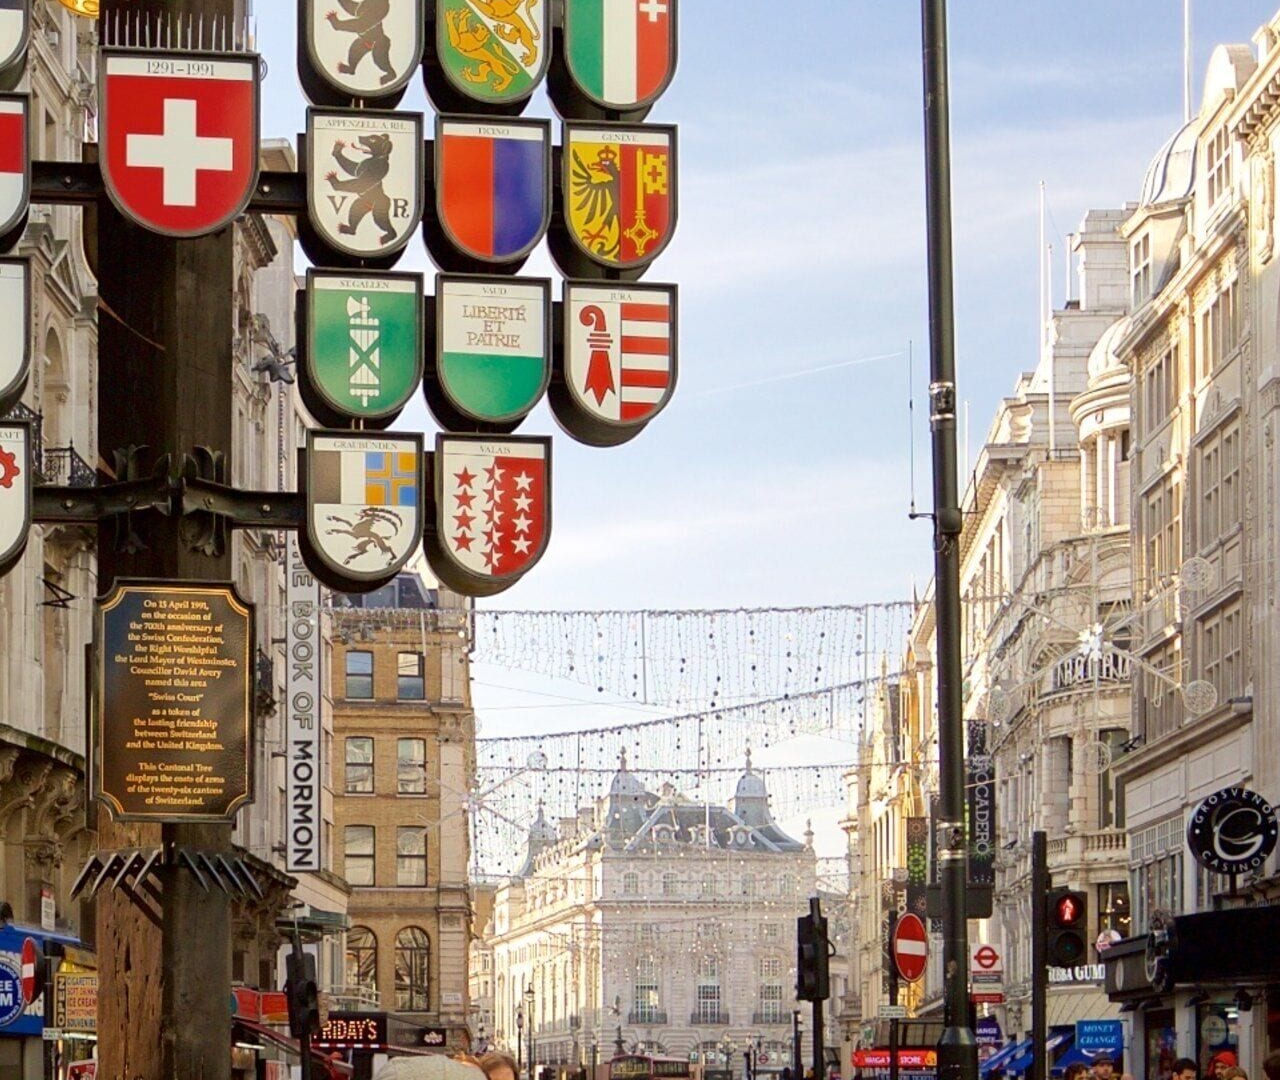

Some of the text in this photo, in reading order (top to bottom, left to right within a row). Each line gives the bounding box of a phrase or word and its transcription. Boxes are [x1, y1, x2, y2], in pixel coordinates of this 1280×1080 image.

[477, 125, 510, 136] TICINO
[328, 195, 409, 218] V R
[482, 286, 508, 295] VAUD
[610, 291, 633, 302] JURA
[462, 304, 527, 323] LIBERTÉ
[483, 320, 505, 333] ET
[466, 331, 520, 348] PATRIE
[479, 445, 512, 456] VALAIS
[144, 600, 156, 608] On
[169, 601, 189, 610] April
[168, 612, 201, 620] occasion
[167, 623, 212, 633] anniversary
[292, 601, 313, 681] BOOK
[135, 644, 148, 652] the
[150, 645, 171, 654] Right
[130, 655, 148, 663] Lord
[150, 656, 175, 665] Mayor
[177, 656, 185, 664] of
[131, 666, 172, 674] Councillor
[199, 669, 222, 678] Avery
[145, 678, 172, 686] named
[174, 679, 189, 687] this
[292, 691, 313, 730] OF
[148, 719, 175, 728] lasting
[176, 720, 218, 729] friendship
[135, 729, 216, 738] between Switzerland
[157, 741, 183, 749] United
[139, 762, 213, 772] This Cantonal Tree
[126, 774, 158, 784] displays
[160, 774, 172, 782] the
[195, 775, 204, 783] of
[145, 796, 154, 804] of
[292, 740, 313, 866] MORMON
[1195, 788, 1277, 824] GROSVENOR
[1202, 851, 1268, 873] CASINOS
[1075, 964, 1106, 981] GUM
[57, 976, 65, 1026] OPEN
[1083, 1025, 1116, 1033] MONEY
[1080, 1036, 1118, 1045] CHANGE
